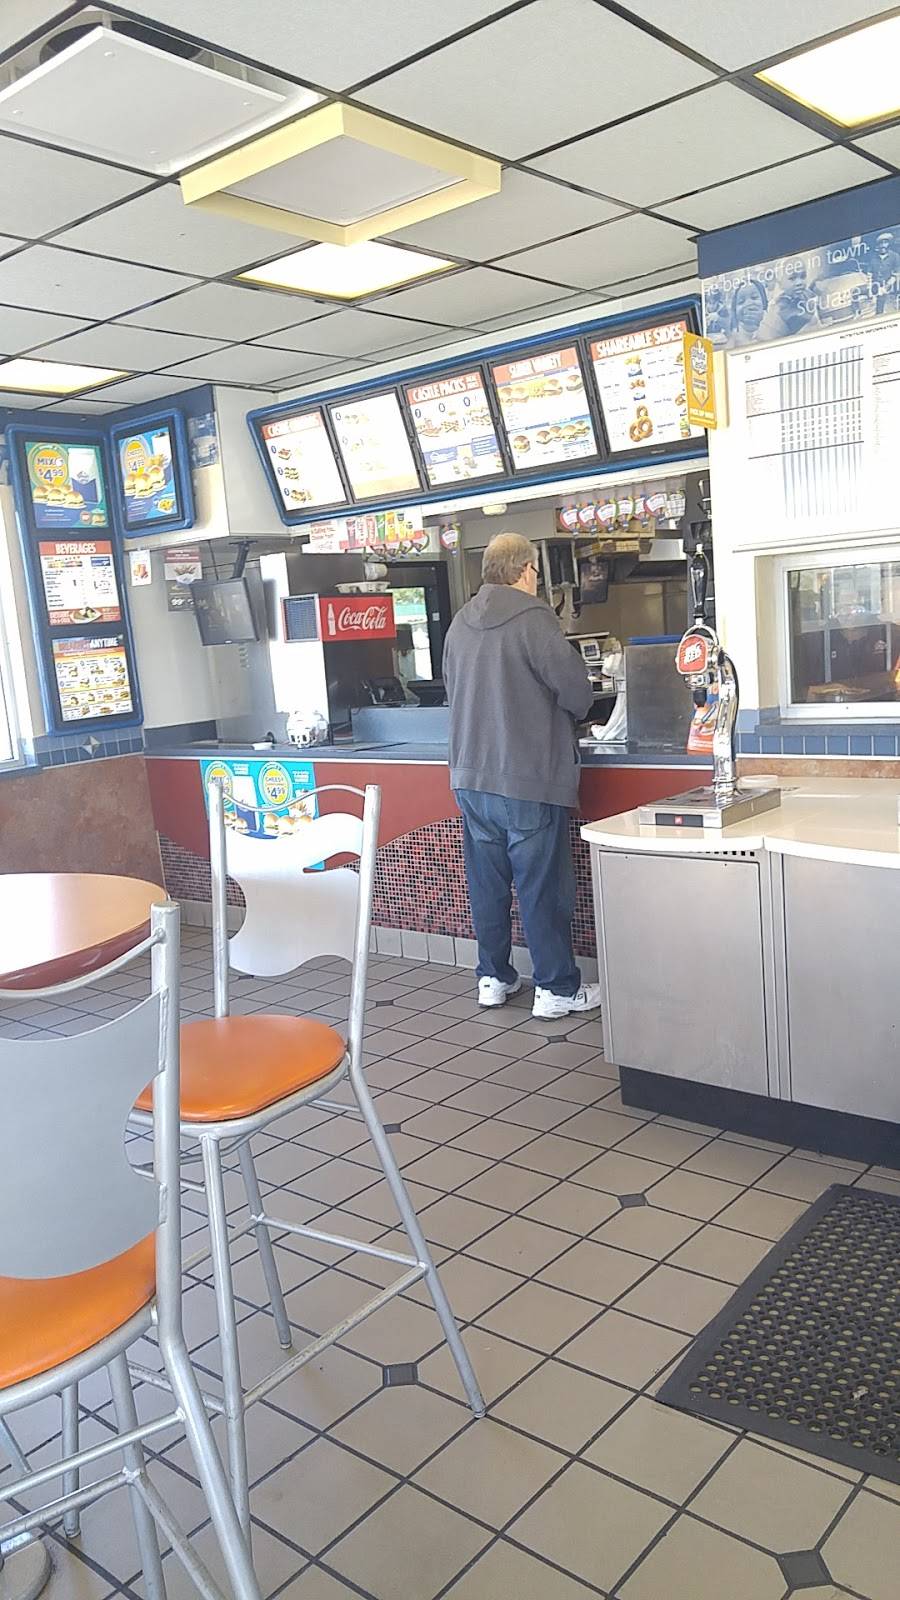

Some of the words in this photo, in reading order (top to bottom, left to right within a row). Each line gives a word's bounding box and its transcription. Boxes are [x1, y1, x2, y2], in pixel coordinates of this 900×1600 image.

[722, 270, 753, 292] best
[756, 260, 803, 283] coffee
[807, 255, 821, 269] in
[826, 241, 870, 264] town.
[797, 286, 862, 317] square
[596, 331, 654, 358] SHAREABLE
[654, 324, 684, 345] SIDES
[412, 384, 440, 402] CASTLE
[440, 378, 467, 397] PACKS
[55, 543, 97, 554] BEVERAGES
[338, 606, 388, 631] Coca-Cola
[89, 637, 120, 649] ANYTIME
